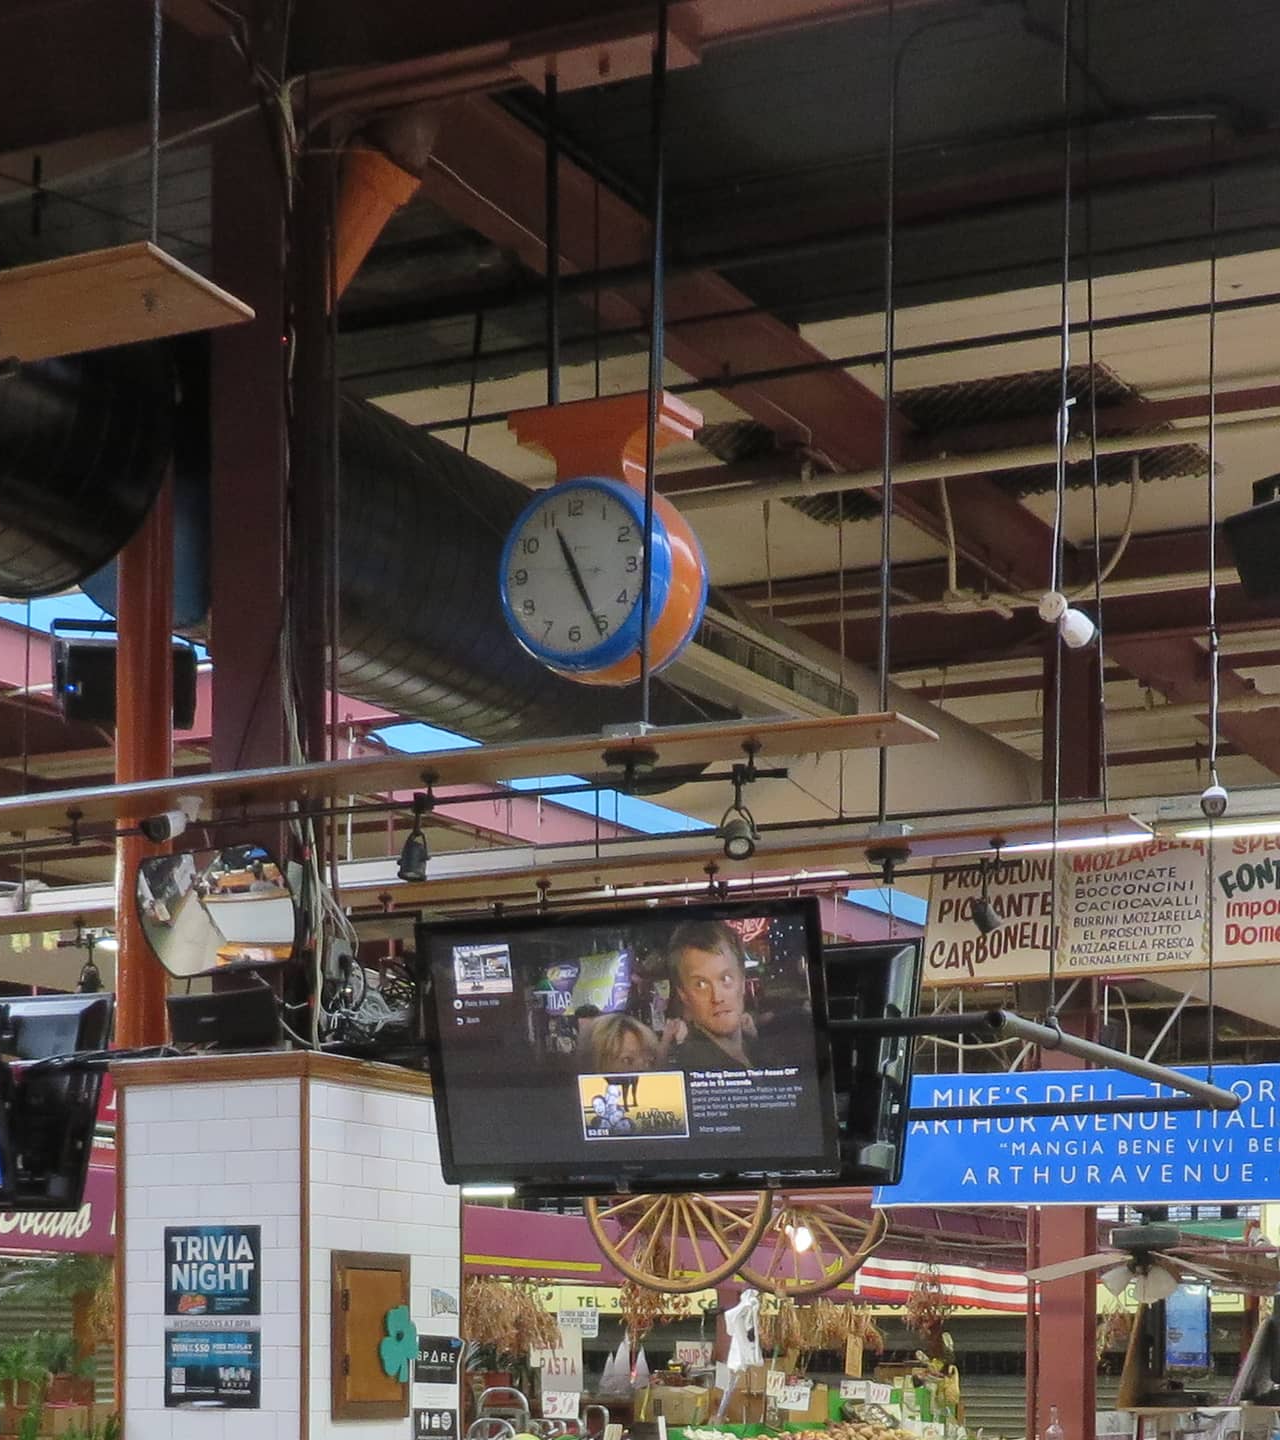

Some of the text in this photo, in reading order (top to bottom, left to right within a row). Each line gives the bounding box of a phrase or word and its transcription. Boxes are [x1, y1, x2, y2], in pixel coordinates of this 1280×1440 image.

[567, 499, 584, 517] 12
[601, 506, 607, 520] 1
[543, 511, 556, 528] 11
[617, 527, 630, 543] 2
[520, 538, 540, 554] 10
[625, 556, 637, 573] 3
[514, 569, 528, 585] 9
[616, 589, 629, 605] 4
[523, 600, 536, 616] 8
[543, 620, 554, 640] 7
[568, 625, 581, 643] 6
[1072, 838, 1206, 873] MOZZARELLA
[1075, 867, 1177, 886] AFFUMICATE
[1075, 881, 1195, 899] BOCCONCINI
[1075, 896, 1199, 913] CACIOCAVALLI
[1073, 909, 1203, 928] BURRINI MOZZARELLA
[1100, 925, 1182, 940] PROSCIUTTO
[930, 922, 1061, 977] CARBONELLI
[1071, 938, 1195, 954] MOZZARELLA FRESCA
[1070, 951, 1193, 966] GIORNALMENTE DAILY
[933, 1085, 1028, 1108] MIKE'S
[1050, 1110, 1178, 1132] AVENUE
[1118, 1138, 1176, 1155] BENE
[1187, 1138, 1234, 1153] VIVI
[171, 1235, 254, 1261] TRIVIA
[577, 1296, 606, 1308] TEL.
[539, 1357, 577, 1377] PASTA
